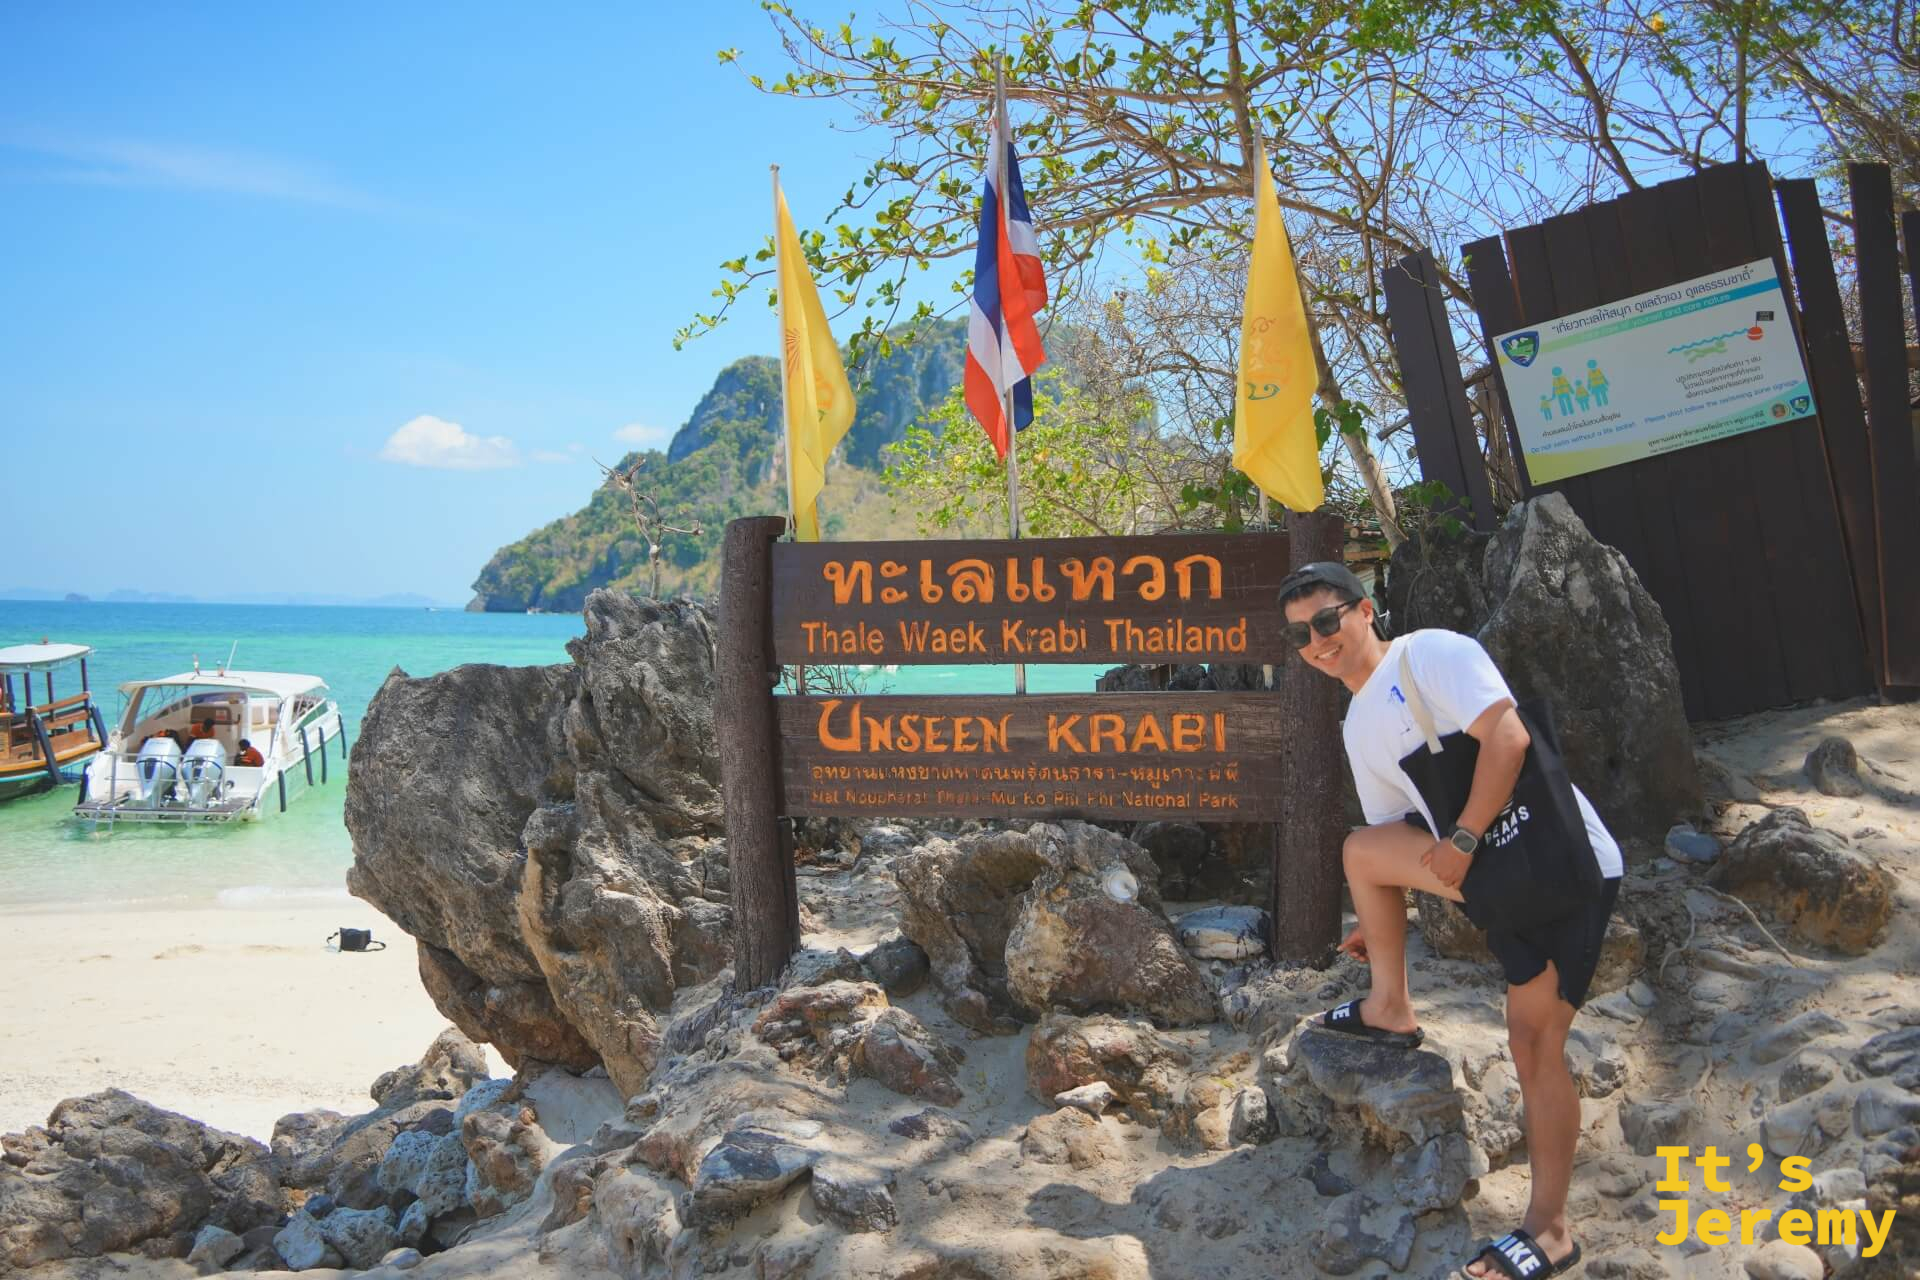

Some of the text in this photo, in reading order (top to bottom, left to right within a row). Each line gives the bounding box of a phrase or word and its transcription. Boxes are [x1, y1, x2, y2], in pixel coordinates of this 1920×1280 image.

[823, 554, 1222, 604] ทะเลแหวก
[801, 616, 1247, 654] Thale Waek Krabi Thailand
[817, 700, 1226, 753] UNSEEN KRABI
[1122, 791, 1190, 808] National
[1200, 791, 1239, 808] Park
